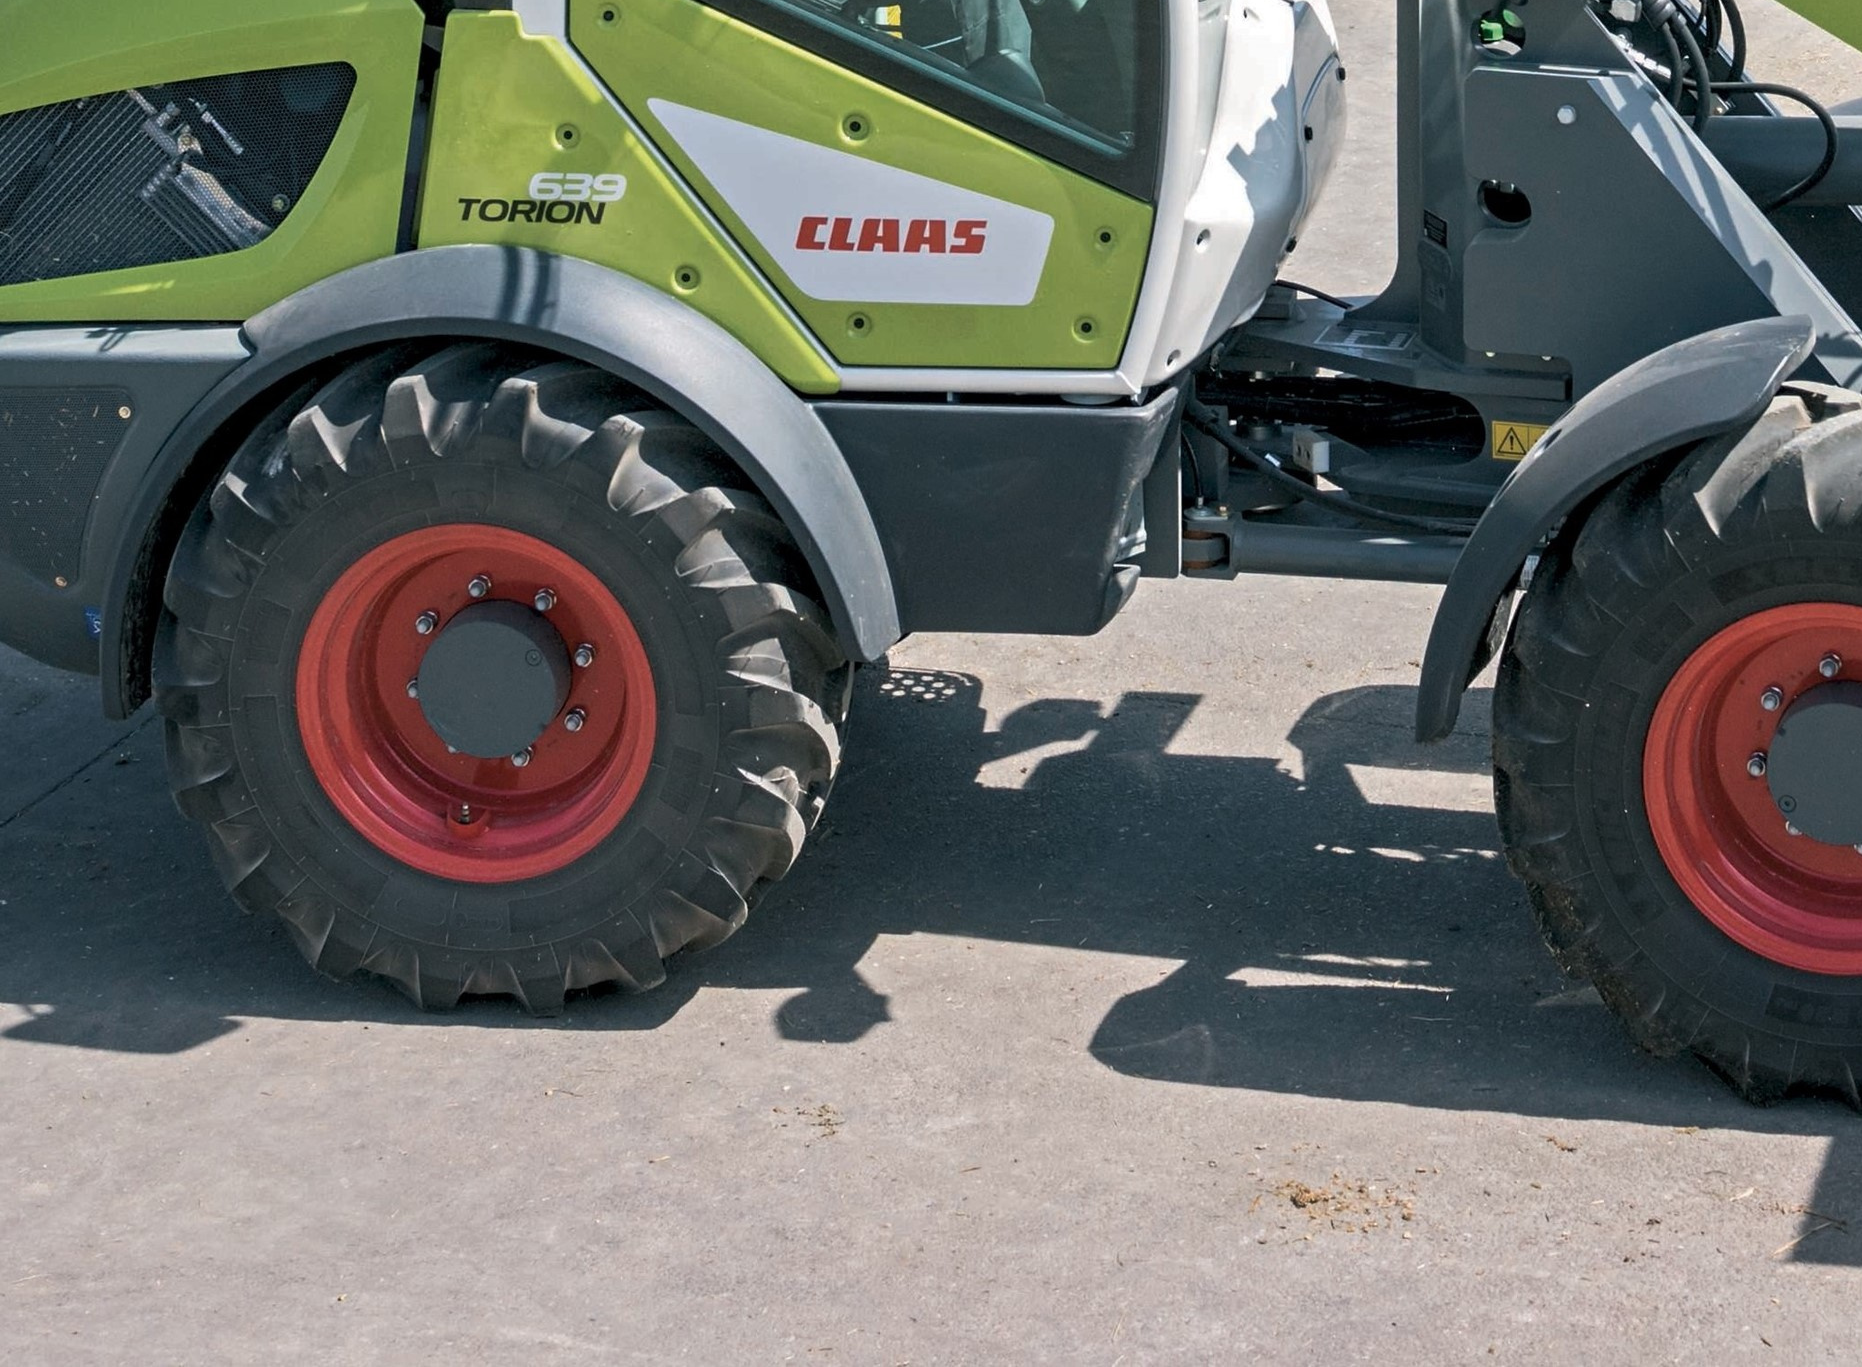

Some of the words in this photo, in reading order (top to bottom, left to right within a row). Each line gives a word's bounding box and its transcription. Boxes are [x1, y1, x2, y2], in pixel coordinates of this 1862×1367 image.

[529, 172, 627, 202] 639
[458, 198, 606, 225] TORION
[795, 216, 988, 255] CLAAS
